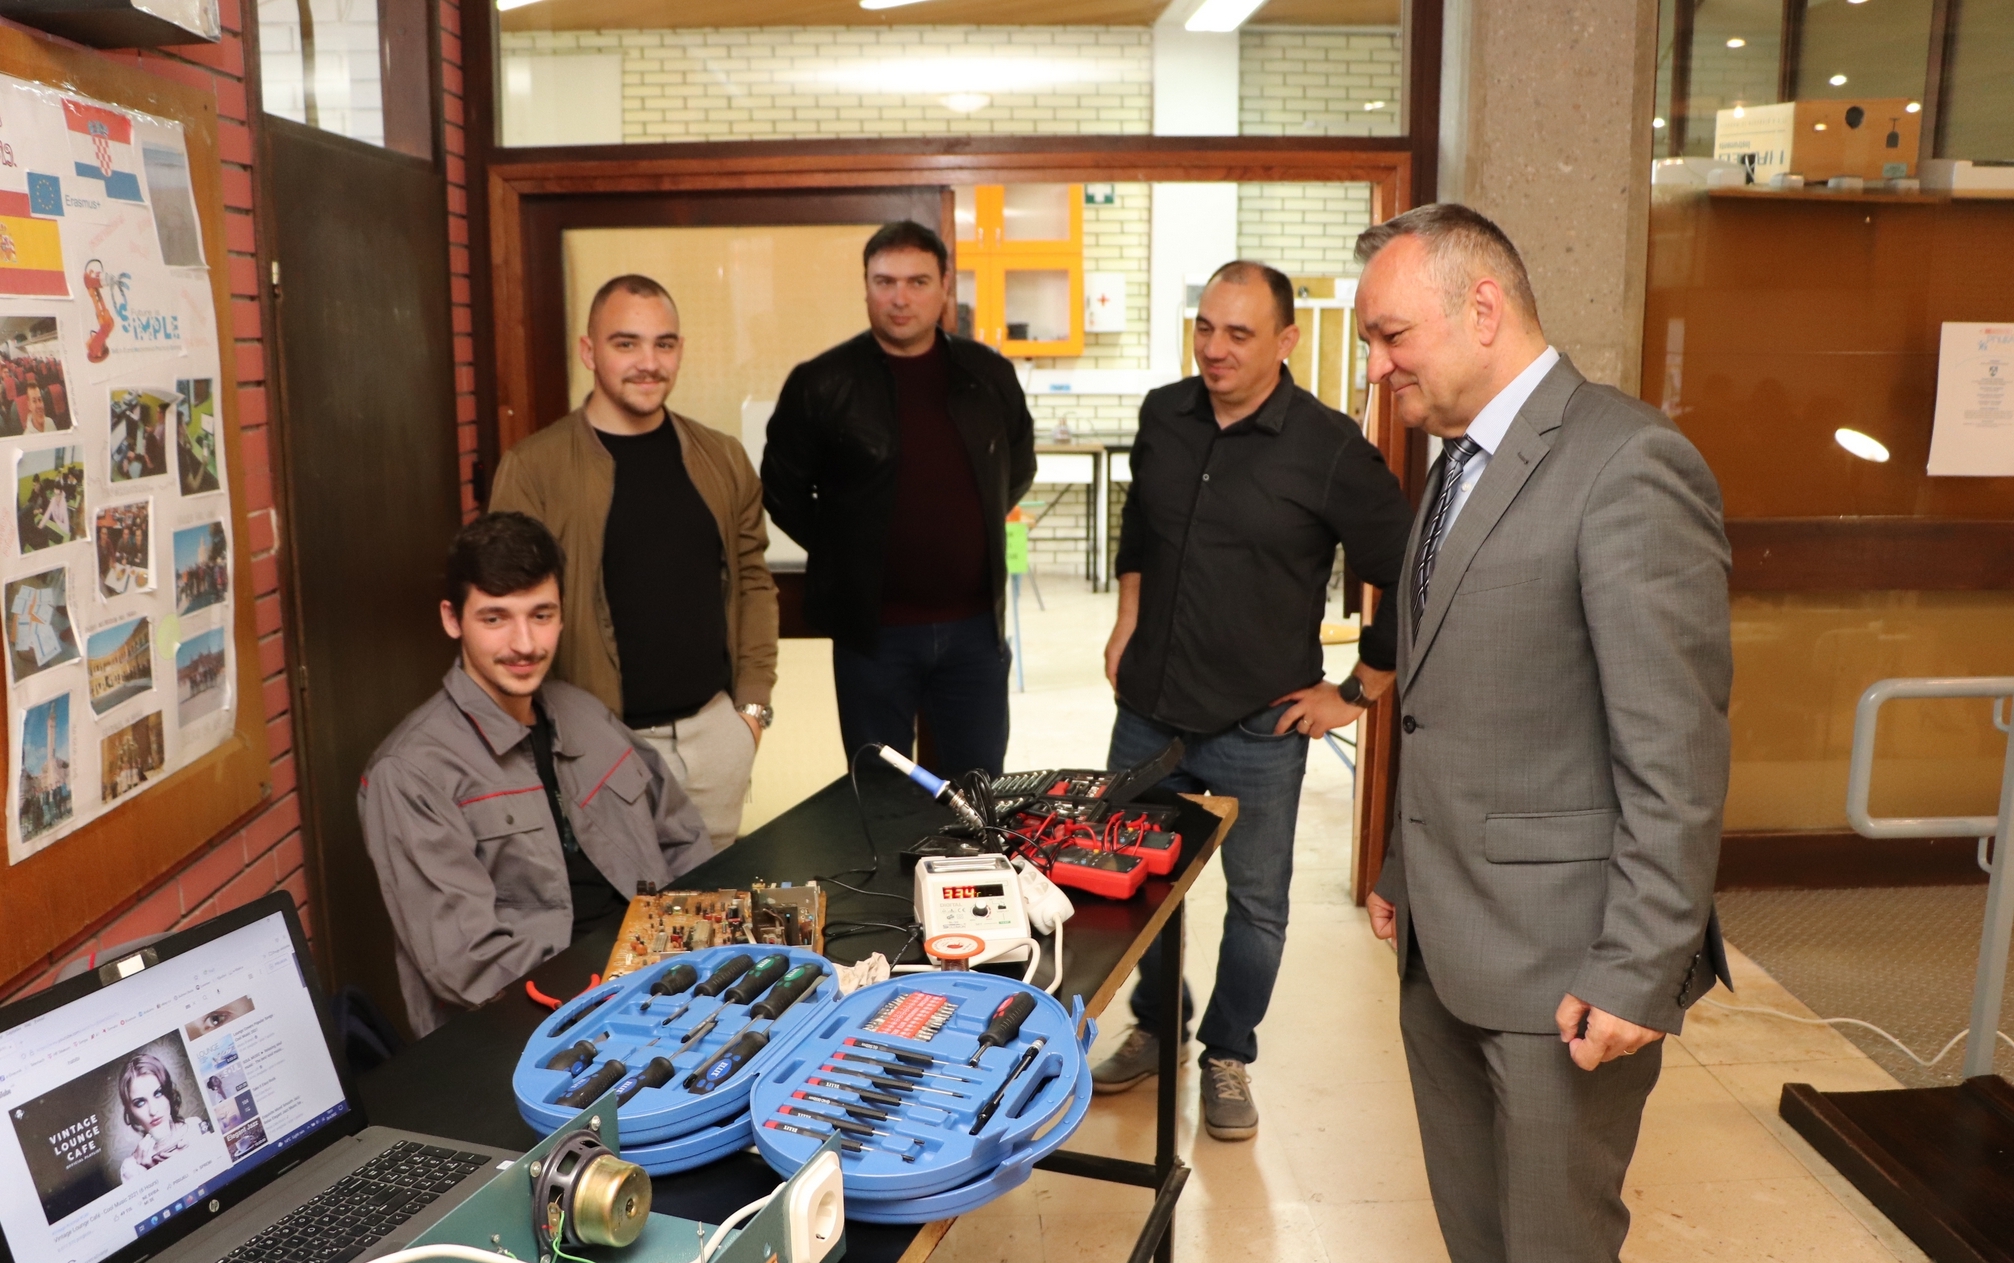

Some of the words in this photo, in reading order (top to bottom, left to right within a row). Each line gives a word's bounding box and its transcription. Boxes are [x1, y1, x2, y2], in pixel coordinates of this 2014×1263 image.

[65, 194, 101, 209] Erasmus+
[944, 888, 975, 899] 334
[196, 1042, 220, 1059] LOUNGE
[711, 1061, 729, 1079] ELLIX
[616, 1080, 634, 1095] ELLIX
[825, 1081, 841, 1090] ELLIX
[49, 1113, 98, 1146] VINTAGE
[227, 1126, 247, 1143] Elegant
[246, 1119, 259, 1131] Jazz
[783, 1124, 799, 1134] ELLIX
[53, 1125, 100, 1156] LOUNGE
[66, 1140, 97, 1162] CAFE
[54, 1229, 73, 1244] Vintage
[72, 1218, 91, 1234] Lounge
[103, 1204, 114, 1214] Cool
[127, 1190, 139, 1200] 2021
